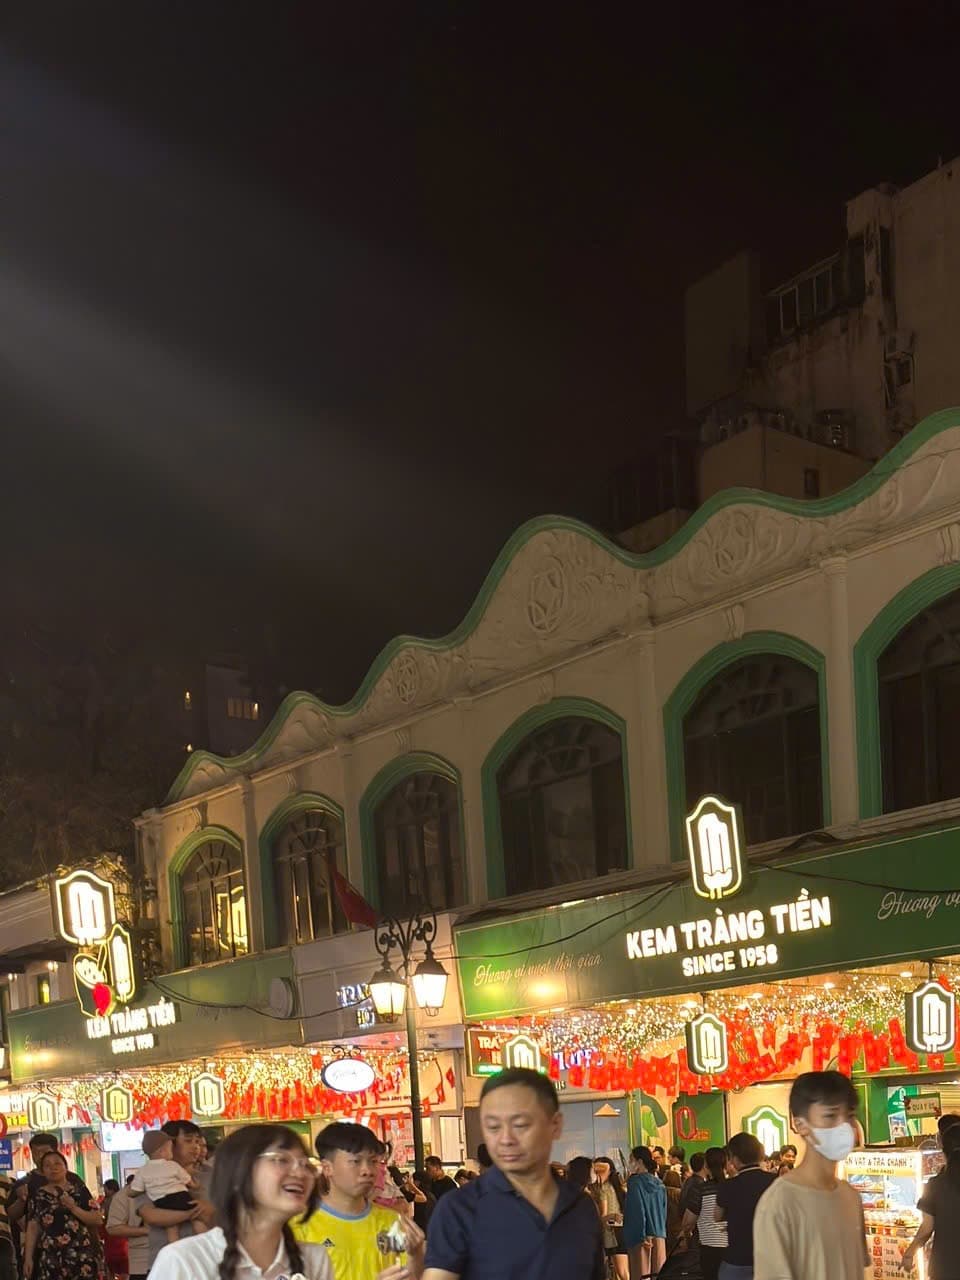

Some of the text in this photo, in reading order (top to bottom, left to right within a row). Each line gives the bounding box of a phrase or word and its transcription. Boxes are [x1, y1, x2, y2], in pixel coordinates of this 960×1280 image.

[626, 888, 832, 960] KEM TRÀNG TIỀN
[682, 943, 778, 976] SINCE 1958
